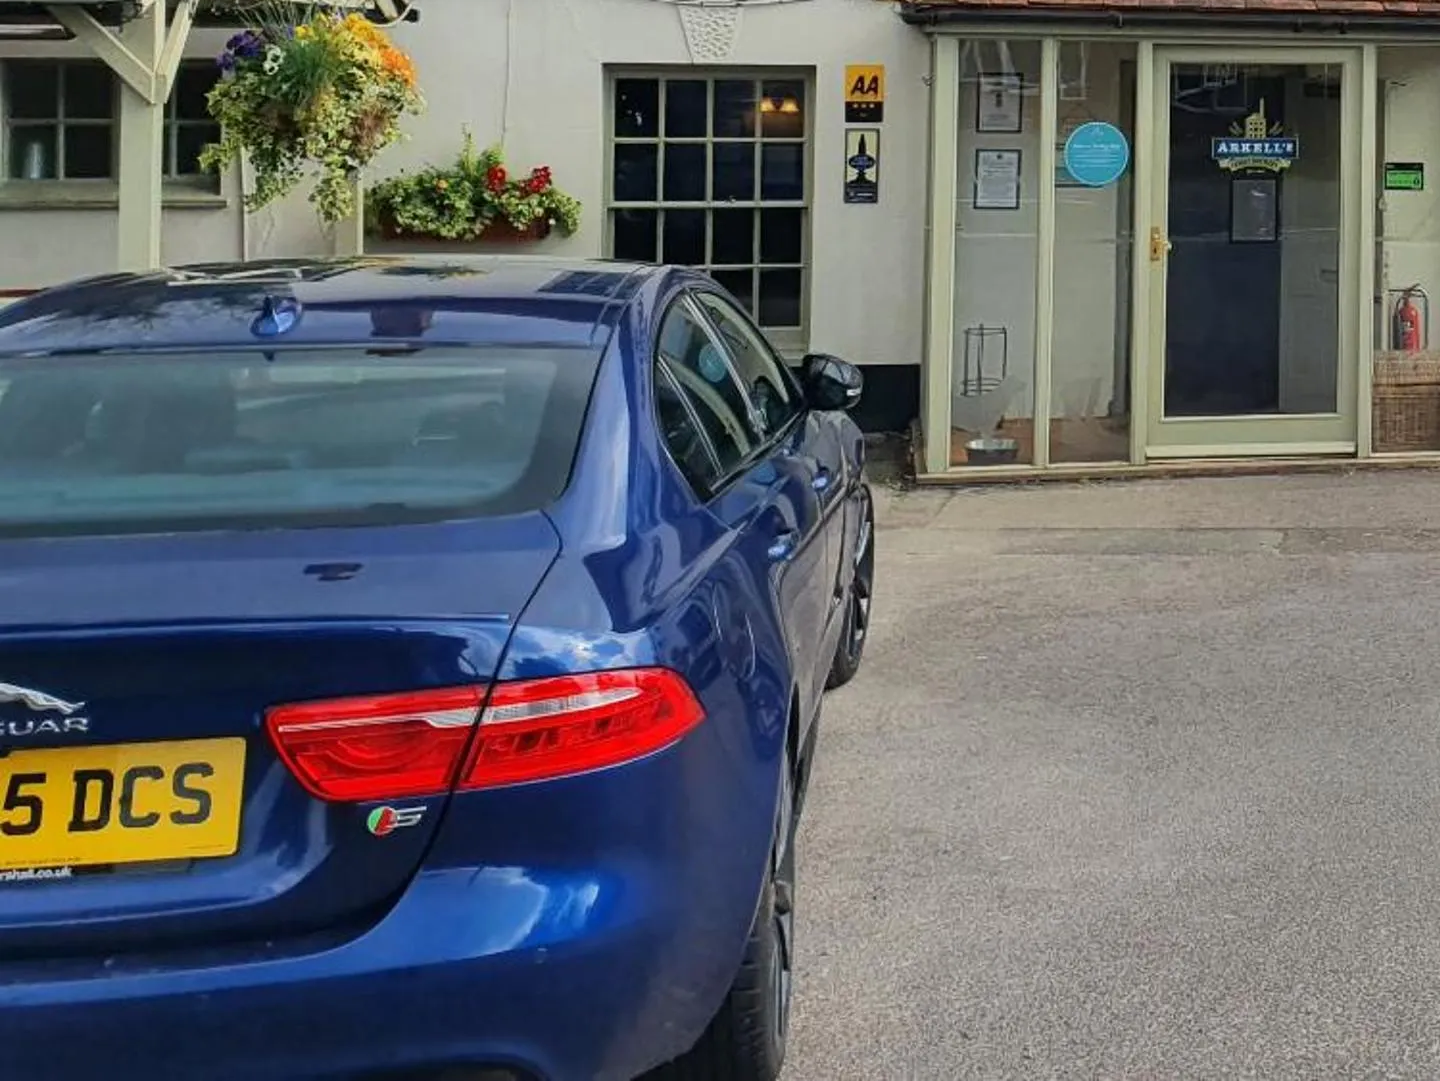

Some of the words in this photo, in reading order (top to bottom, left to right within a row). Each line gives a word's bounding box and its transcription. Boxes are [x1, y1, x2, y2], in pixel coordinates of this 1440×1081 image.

[850, 75, 879, 97] AA
[0, 717, 89, 736] UAR
[1, 773, 46, 835] 5
[68, 762, 214, 832] DCS
